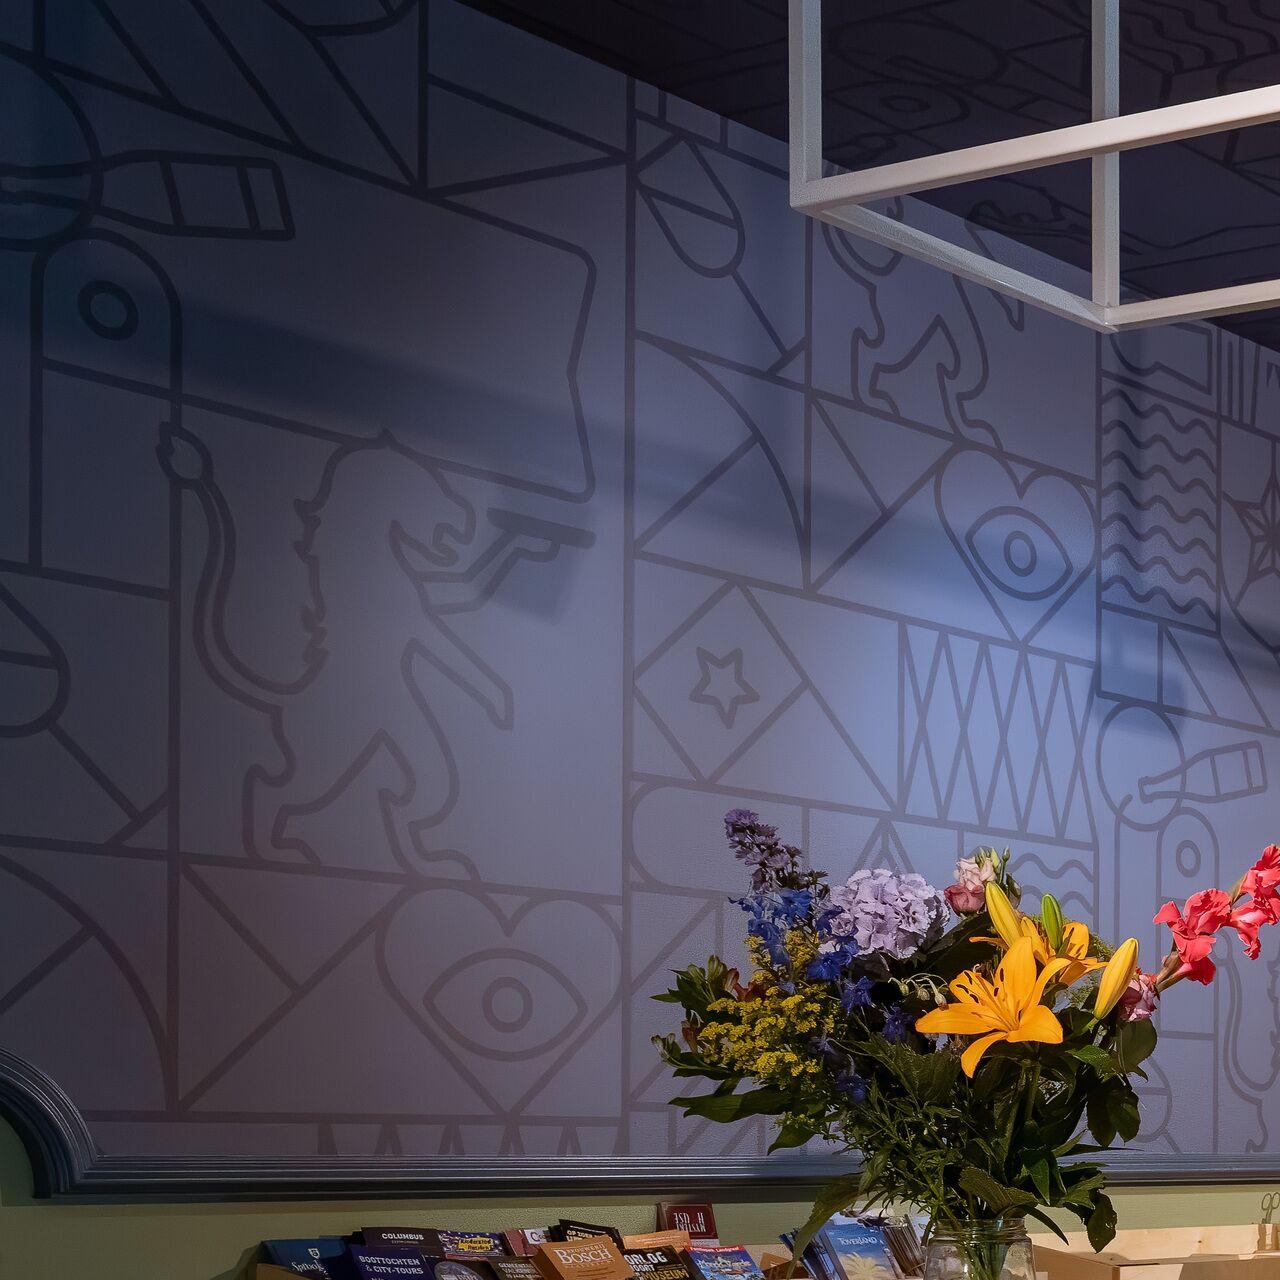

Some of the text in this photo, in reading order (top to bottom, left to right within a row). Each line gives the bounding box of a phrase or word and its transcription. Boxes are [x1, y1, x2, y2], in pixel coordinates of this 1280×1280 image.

[359, 1255, 420, 1266] BOOTTOCHTEN
[554, 1249, 613, 1264] BOSCH
[623, 1251, 668, 1266] ORLOG
[373, 1266, 424, 1275] CITY-TOURS
[643, 1269, 690, 1280] MUSEUM
